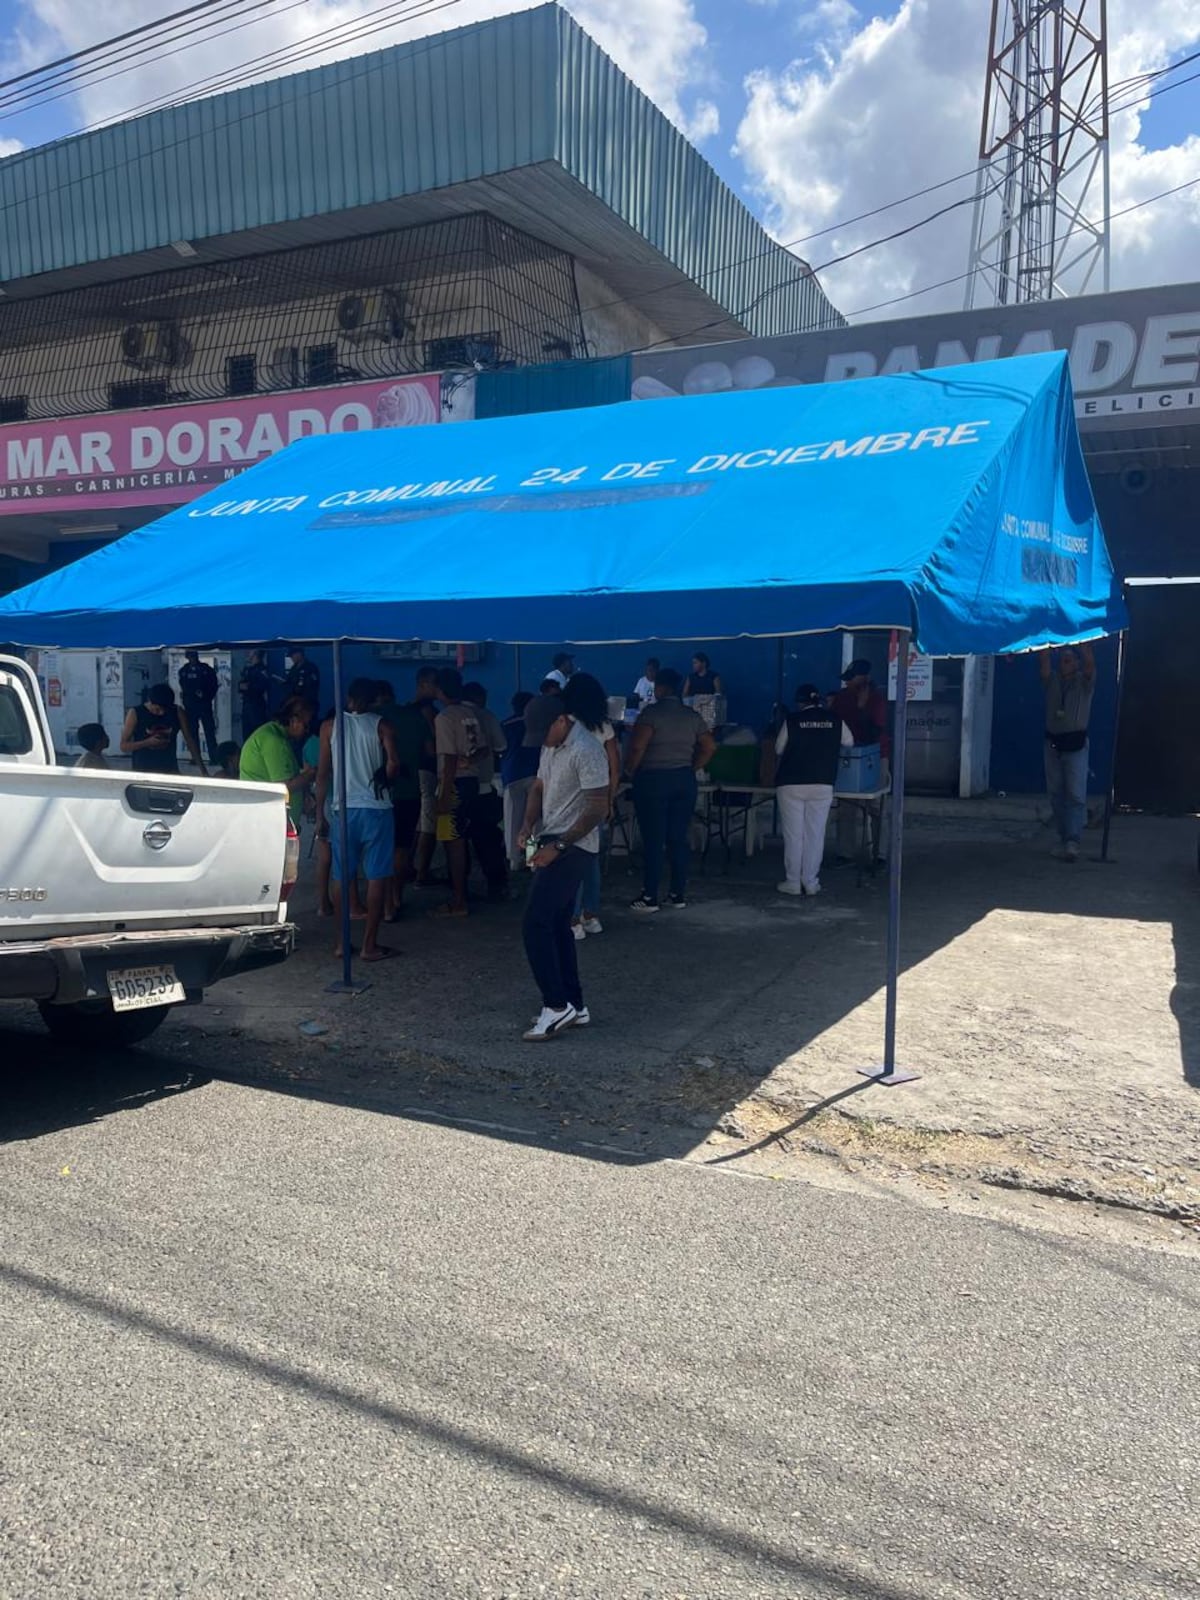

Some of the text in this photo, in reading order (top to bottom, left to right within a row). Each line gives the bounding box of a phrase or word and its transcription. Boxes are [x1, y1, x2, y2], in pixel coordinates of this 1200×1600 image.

[7, 402, 374, 481] MAR DORADO
[189, 420, 990, 518] JUNTA COMUNAL 24 DE DICIEMBRE
